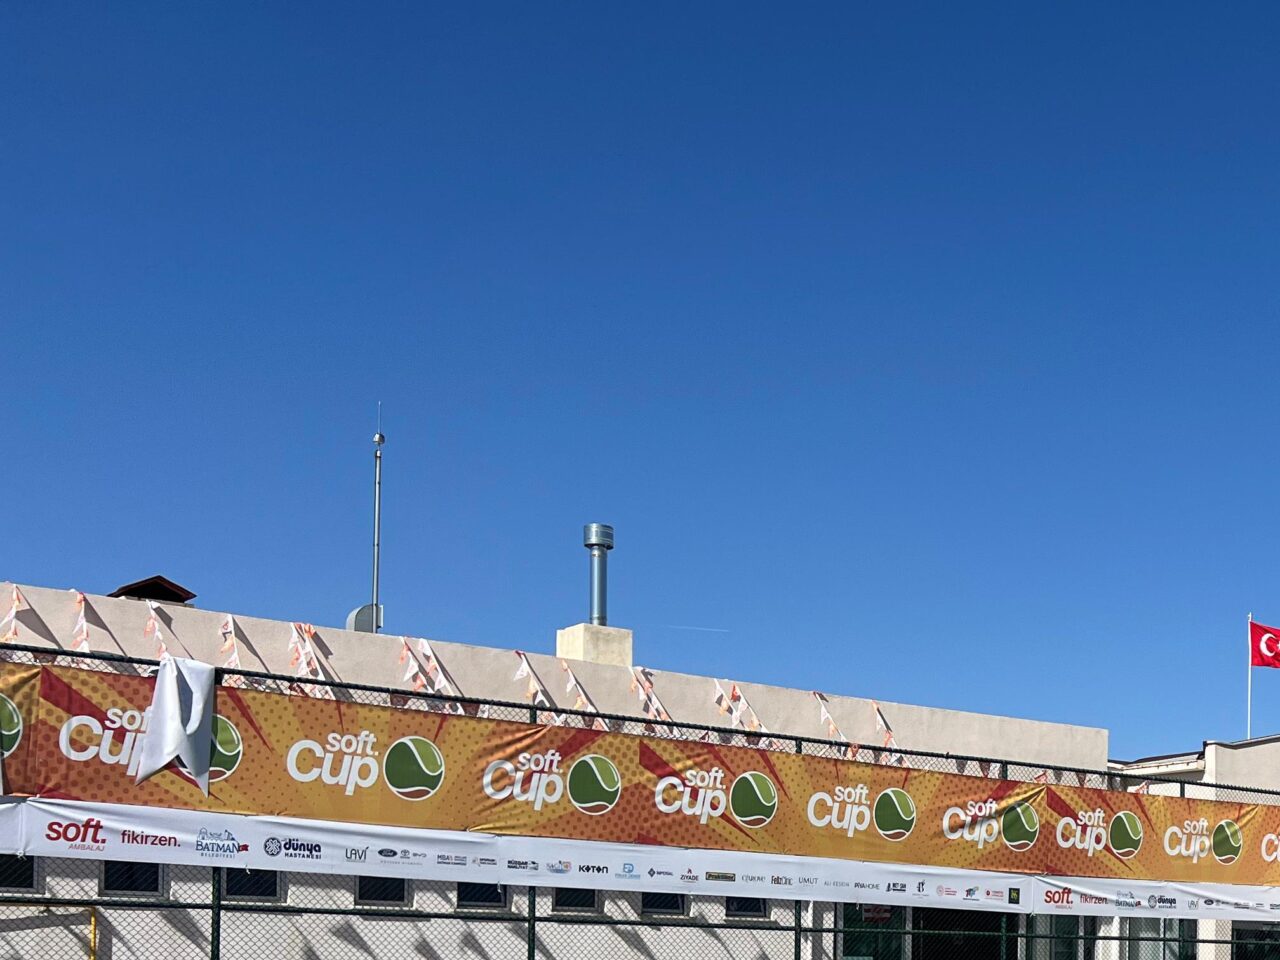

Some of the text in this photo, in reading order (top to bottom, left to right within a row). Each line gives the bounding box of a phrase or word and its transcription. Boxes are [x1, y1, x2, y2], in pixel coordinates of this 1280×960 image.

[105, 706, 152, 732] sof
[325, 730, 380, 756] soft.
[286, 739, 380, 796] Cup
[481, 759, 564, 811] Cup
[654, 776, 727, 824] Cup
[806, 791, 871, 838] Cup
[942, 806, 999, 849] Cup
[45, 818, 106, 844] soft.
[120, 829, 181, 847] fikirzen.
[1055, 816, 1107, 857] Cup
[195, 840, 240, 854] BATMAN
[283, 838, 322, 855] dünya
[1163, 825, 1211, 864] Cup
[798, 877, 819, 885] UMUT
[1044, 887, 1073, 905] soft.
